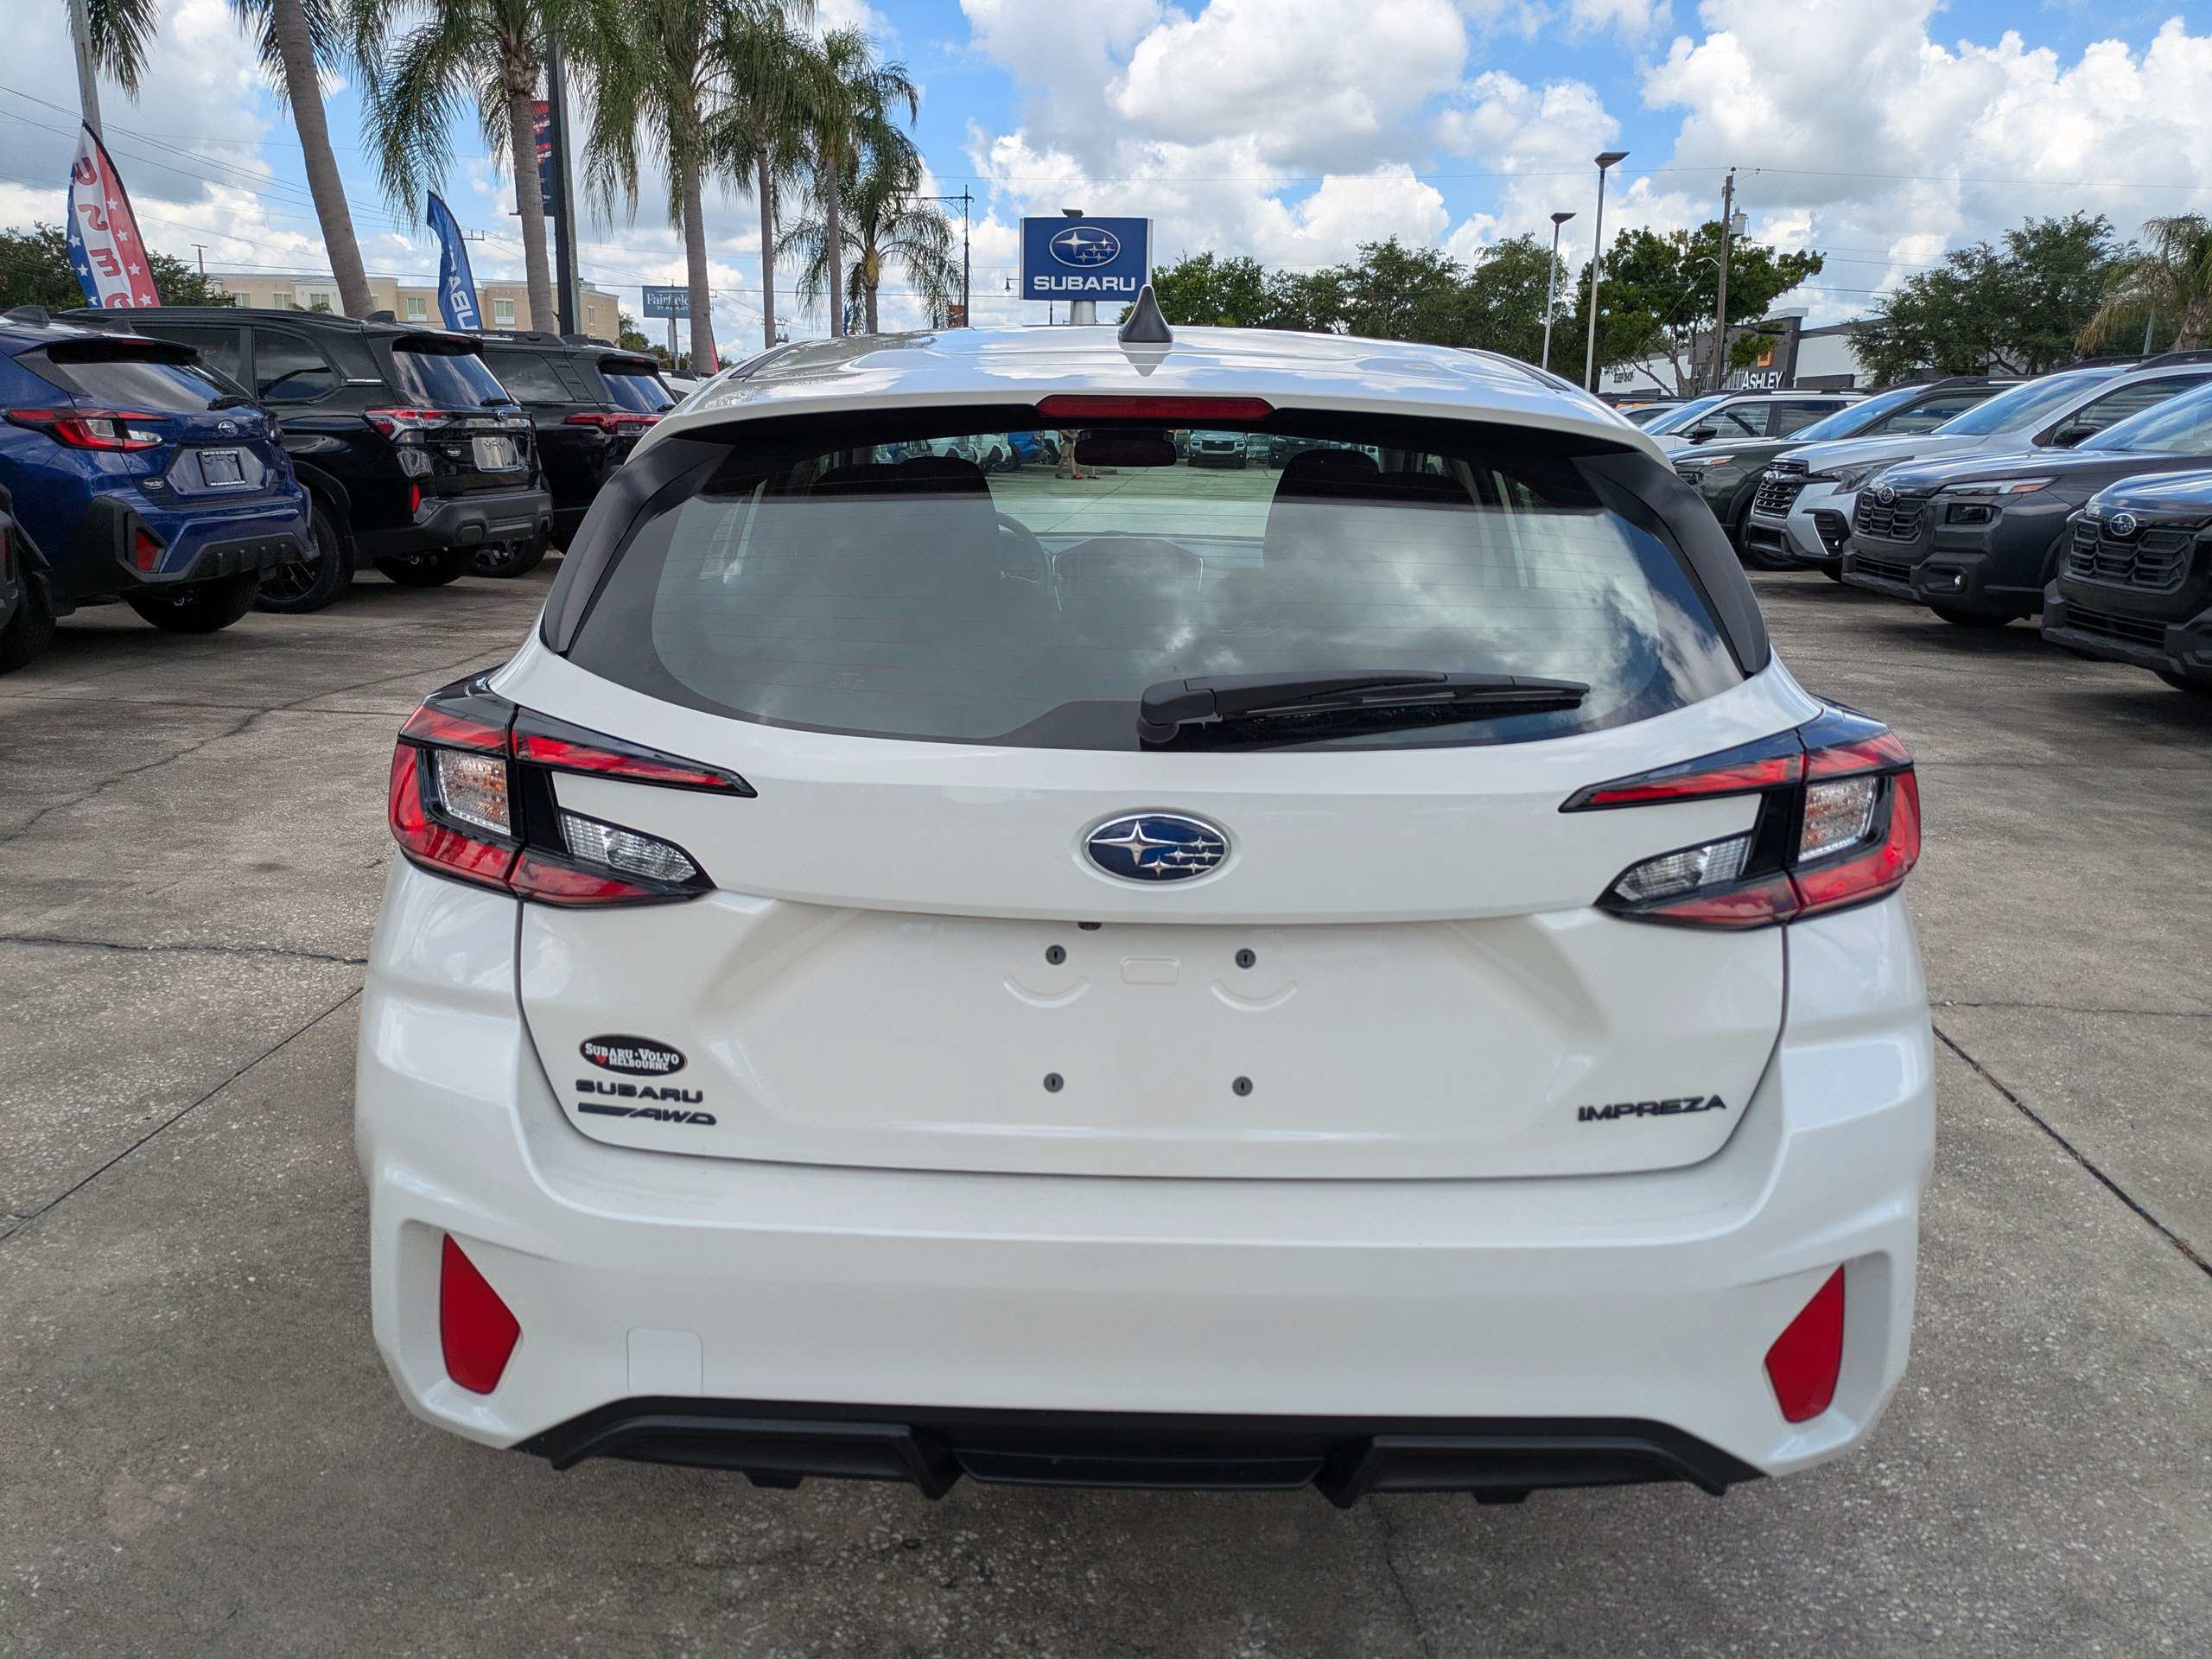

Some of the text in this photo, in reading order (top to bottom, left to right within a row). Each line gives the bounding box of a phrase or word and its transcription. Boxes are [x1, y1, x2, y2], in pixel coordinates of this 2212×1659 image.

[1033, 275, 1136, 291] SUBARU
[1741, 371, 1783, 390] ASHLEY
[608, 1056, 670, 1072] MELBOURNE
[575, 1078, 703, 1104] SUBARU
[628, 1107, 717, 1126] AWD
[1578, 1094, 1727, 1122] IMPREZA
